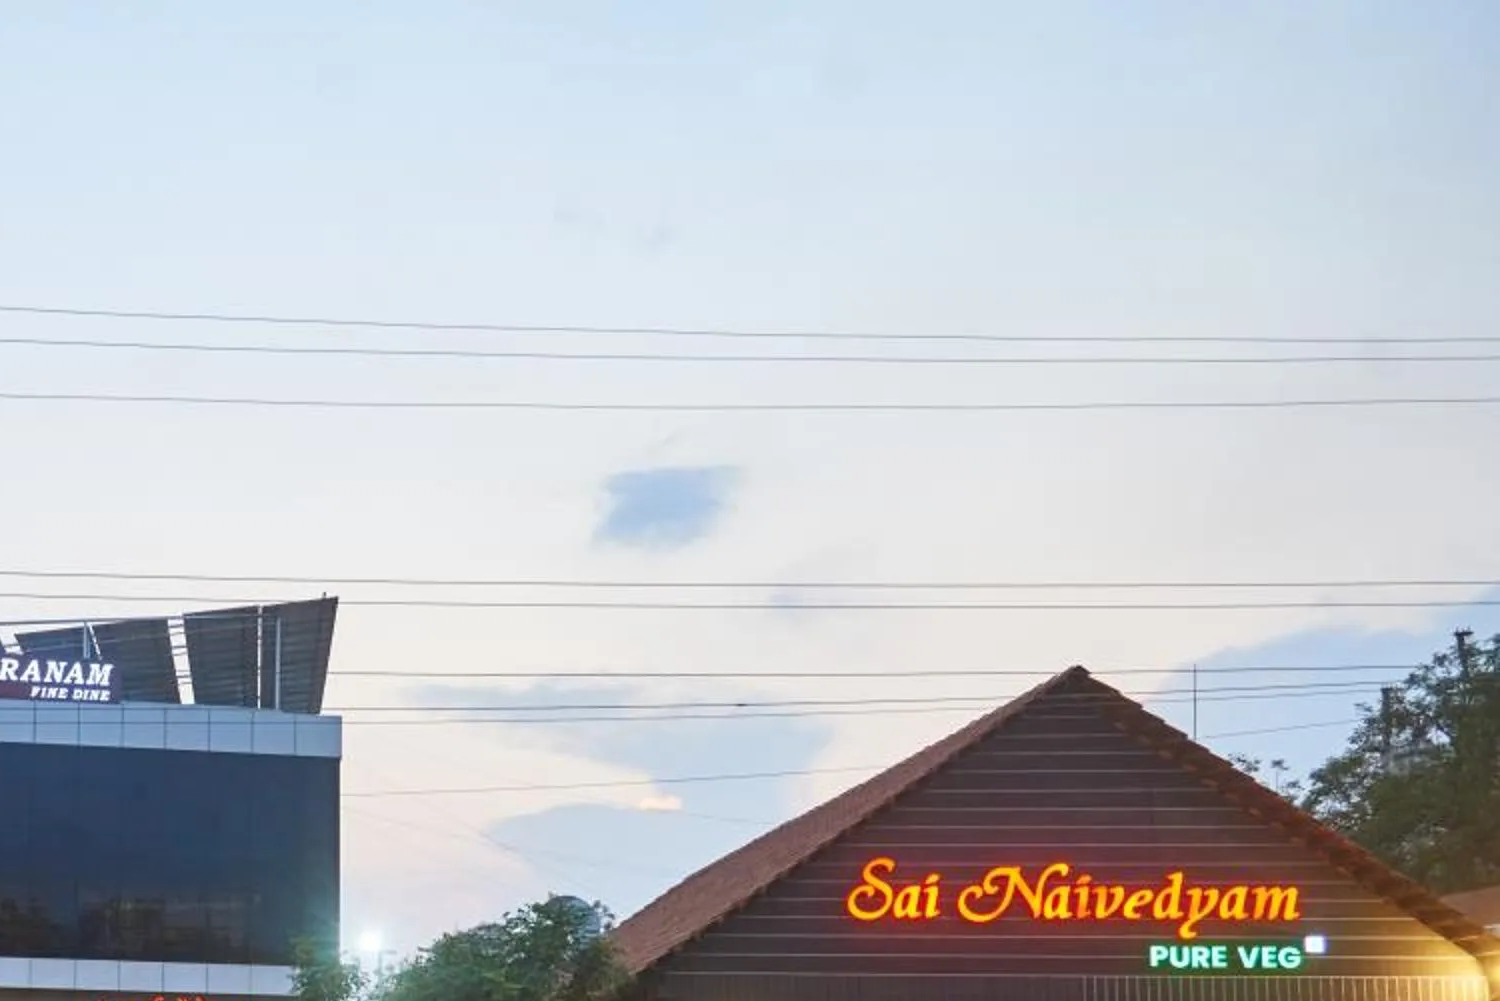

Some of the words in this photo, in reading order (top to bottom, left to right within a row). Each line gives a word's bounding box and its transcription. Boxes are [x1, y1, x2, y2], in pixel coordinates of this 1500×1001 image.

[30, 686, 68, 698] FINE
[73, 689, 111, 701] DINE
[846, 857, 941, 921] Sai
[957, 863, 1300, 939] Naivedyam
[1150, 945, 1227, 968] PURE
[1237, 946, 1301, 969] VEG
